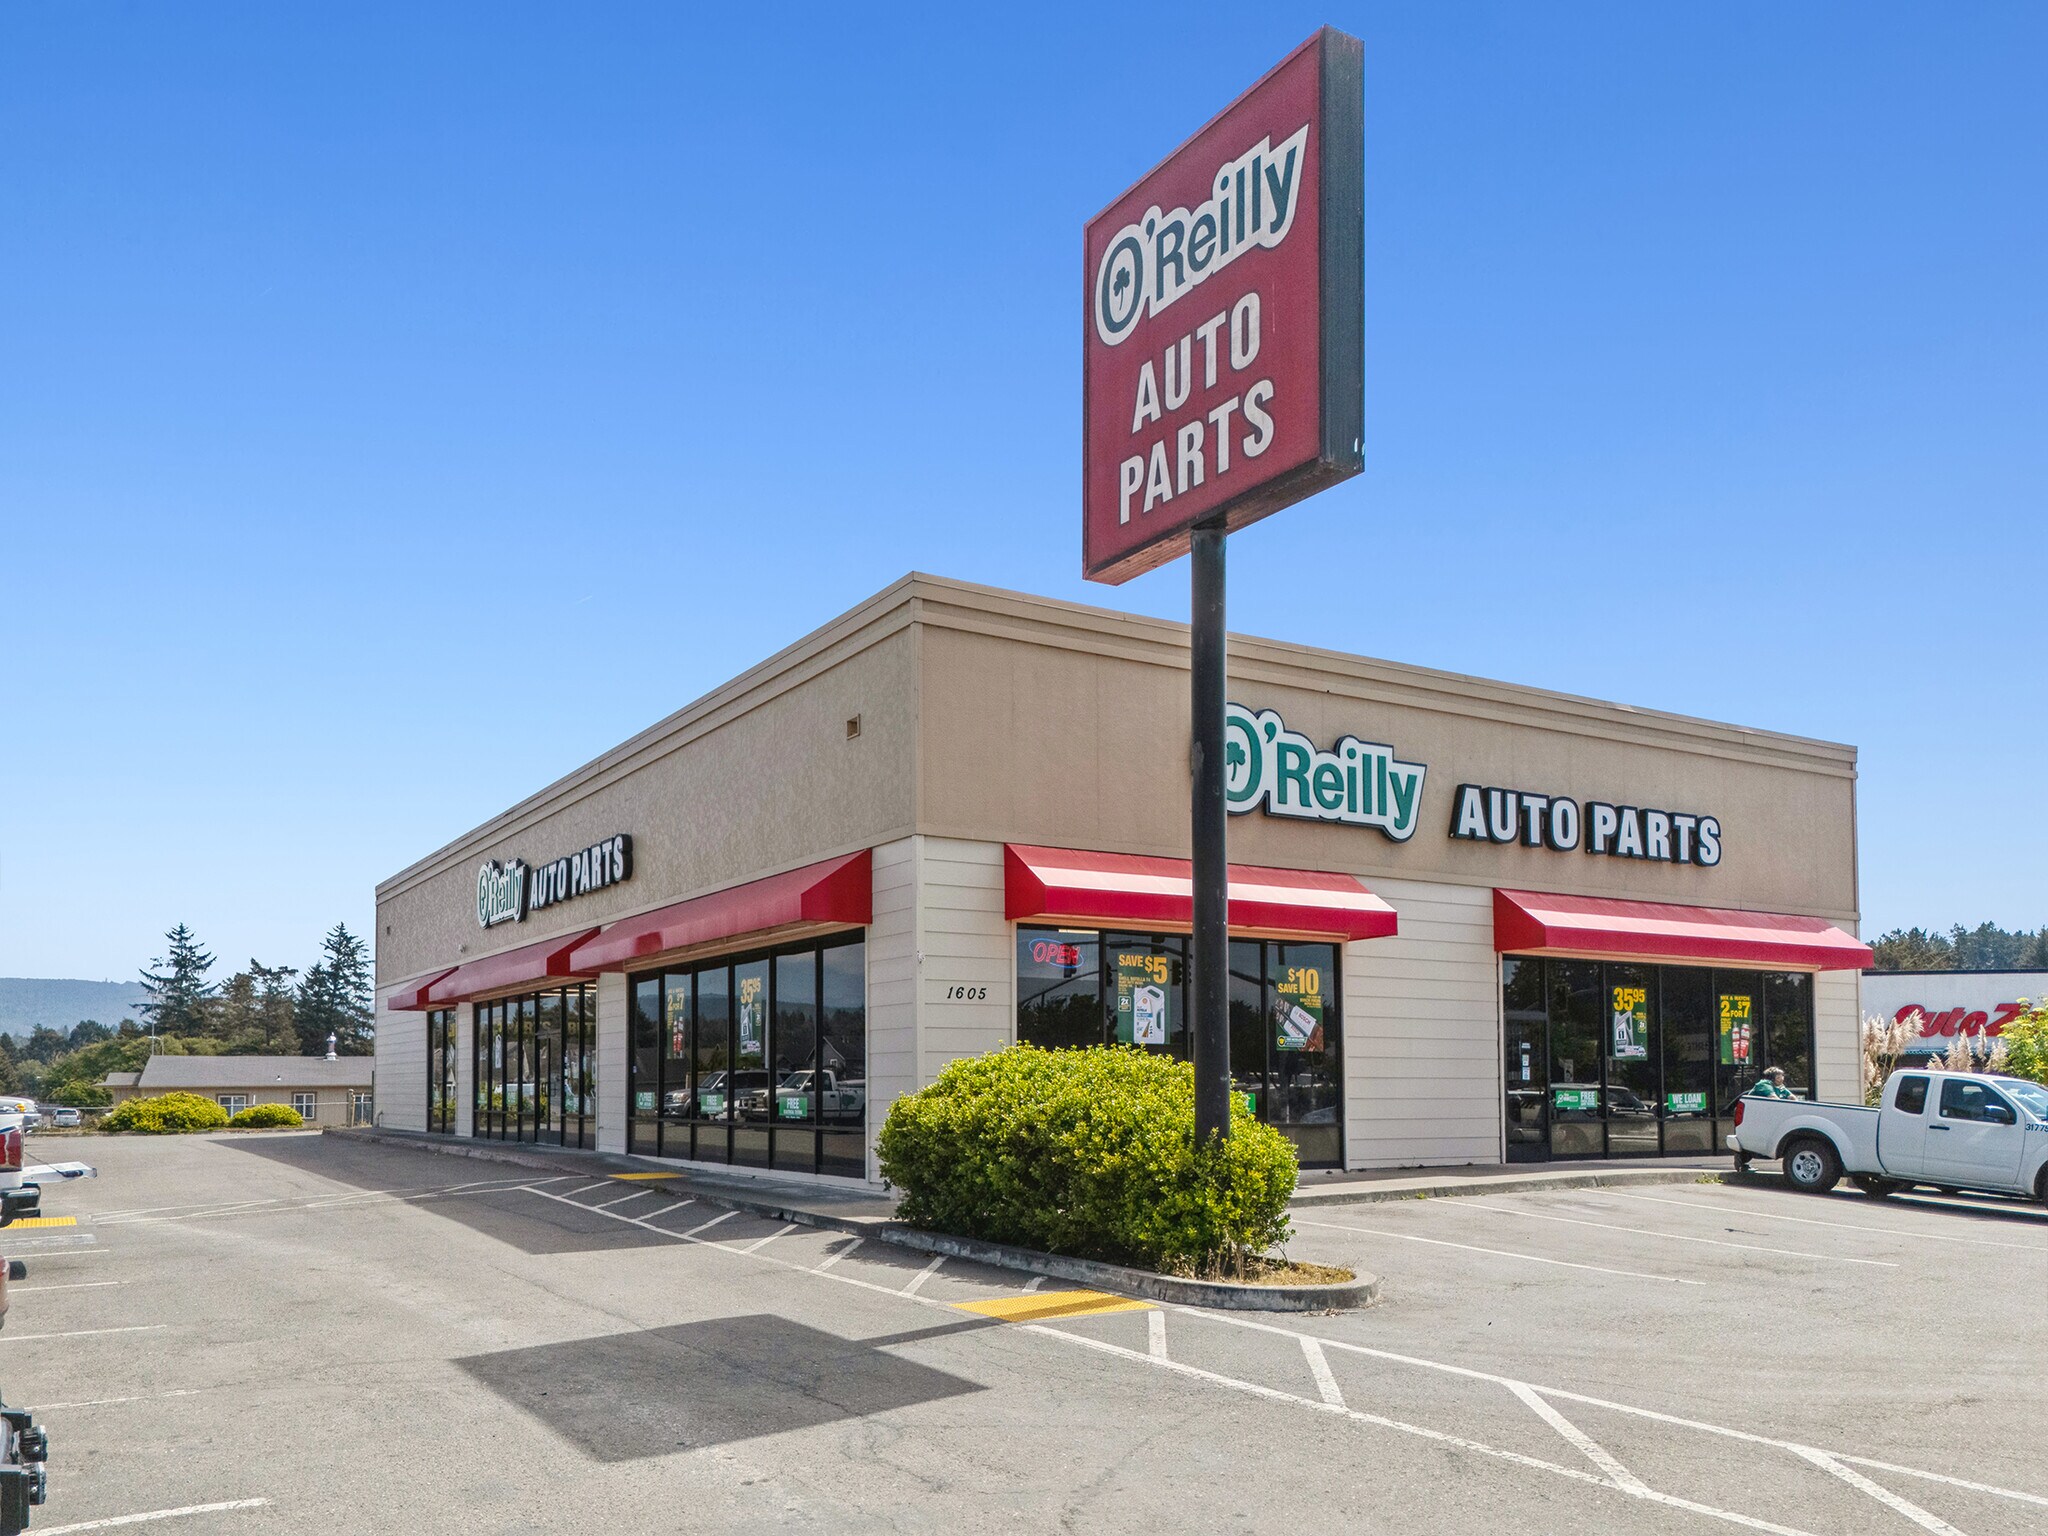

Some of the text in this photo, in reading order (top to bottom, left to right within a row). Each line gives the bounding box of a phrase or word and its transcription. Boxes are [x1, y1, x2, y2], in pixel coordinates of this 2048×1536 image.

[1101, 140, 1299, 336] O'Reilly
[1132, 292, 1260, 434] AUTO
[1120, 379, 1274, 525] PARTS
[1226, 713, 1720, 864] O'Reilly AUTO PARTS
[478, 835, 624, 924] O'Reilly AUTO PARTS
[1033, 942, 1081, 965] OPEN
[1118, 954, 1168, 985] SAVE $5
[947, 986, 987, 1000] 1605
[1277, 982, 1298, 994] SAVE
[1720, 1000, 1730, 1017] 2
[1730, 1010, 1743, 1018] FOR
[1888, 1003, 2044, 1038] AutoZ
[786, 1098, 800, 1110] FREE
[1580, 1091, 1596, 1101] FREE
[1671, 1093, 1702, 1104] WE LOAN
